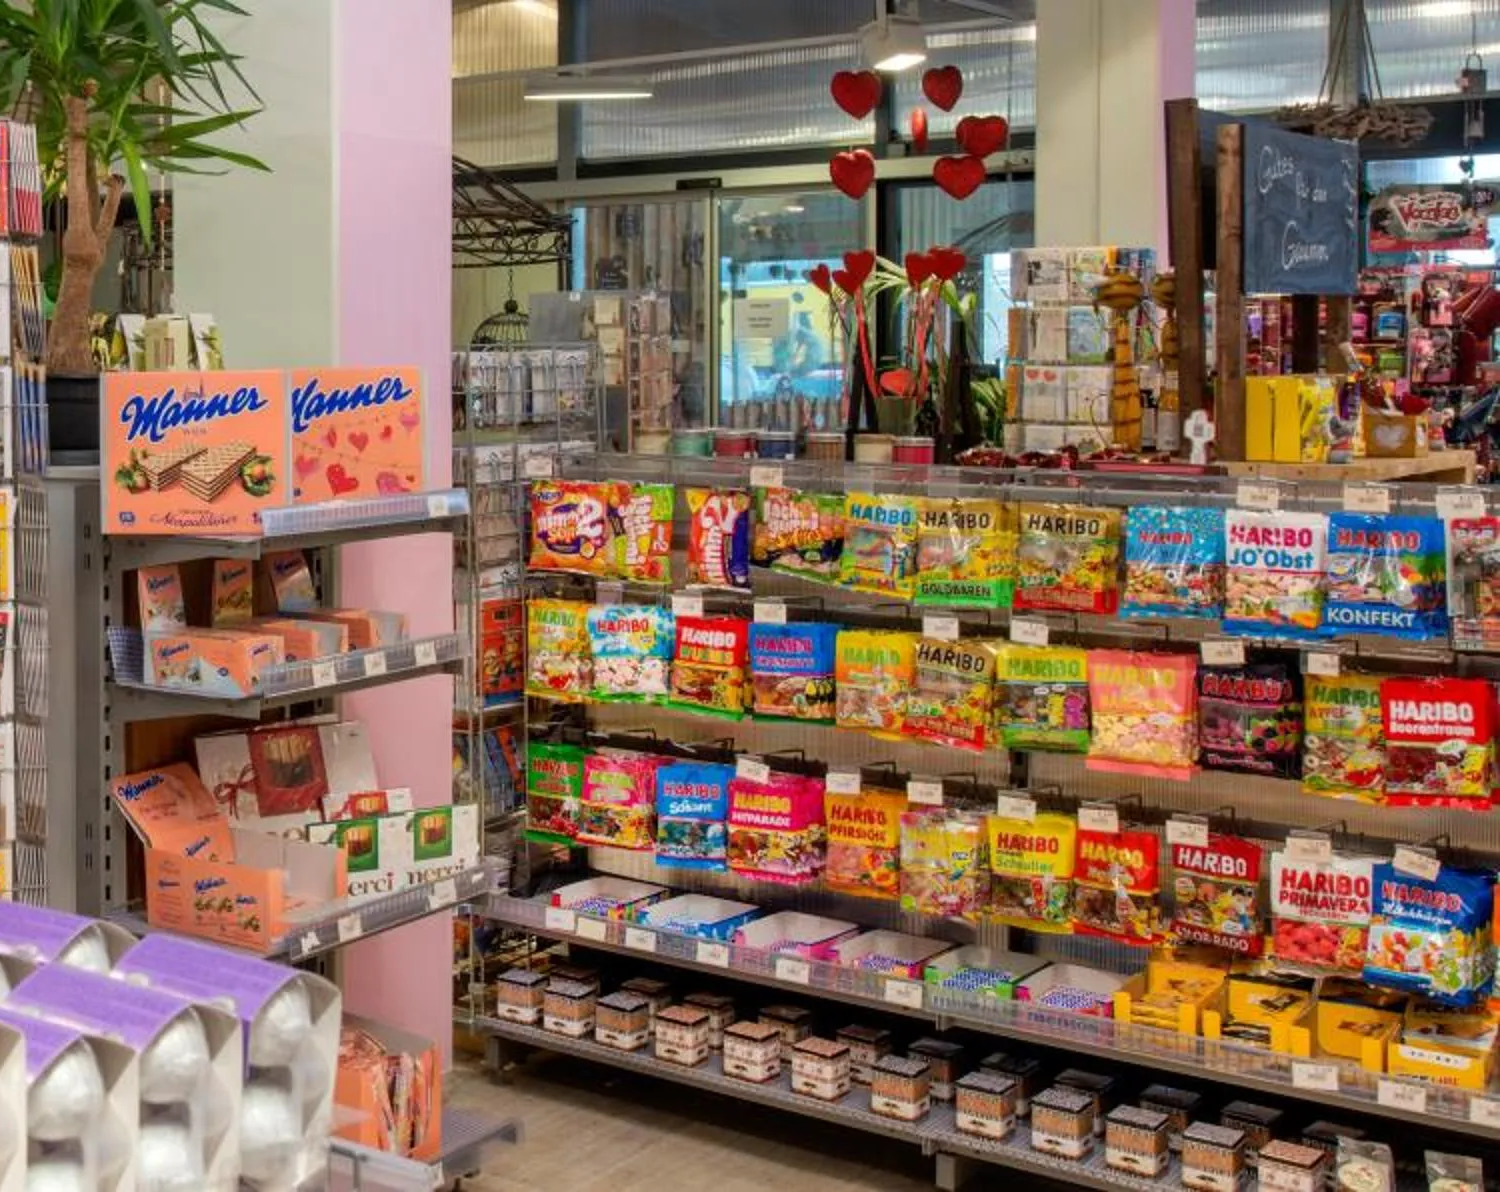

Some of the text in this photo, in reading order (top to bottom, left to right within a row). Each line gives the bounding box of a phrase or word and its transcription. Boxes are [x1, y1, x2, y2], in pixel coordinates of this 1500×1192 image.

[121, 387, 268, 442] Manner
[850, 503, 912, 527] HARIBO
[924, 510, 991, 530] HARIBO
[1027, 513, 1100, 536] HARIBO
[1228, 524, 1314, 550] HARIBO
[1336, 528, 1421, 551] HARIBO
[596, 618, 650, 634] HARIBO
[1326, 606, 1416, 629] KONFEKT
[680, 626, 737, 648] HARIBO
[917, 643, 985, 673] HARIBO
[1008, 656, 1080, 677] HARIBO
[1314, 685, 1380, 708] HARIBO
[1389, 700, 1474, 724] HARIBO
[663, 783, 722, 800] HARIBO
[734, 794, 791, 813] HARIBO
[831, 803, 887, 825] HARIBO
[996, 830, 1060, 854] HARIBO
[1081, 840, 1143, 869] HARIBO
[1177, 847, 1248, 878] HARIBO
[406, 857, 466, 886] merci
[1280, 867, 1370, 898] HARIBO
[347, 872, 395, 897] erci
[1381, 879, 1461, 913] HARIBO
[1279, 888, 1370, 914] PRIMAVERA
